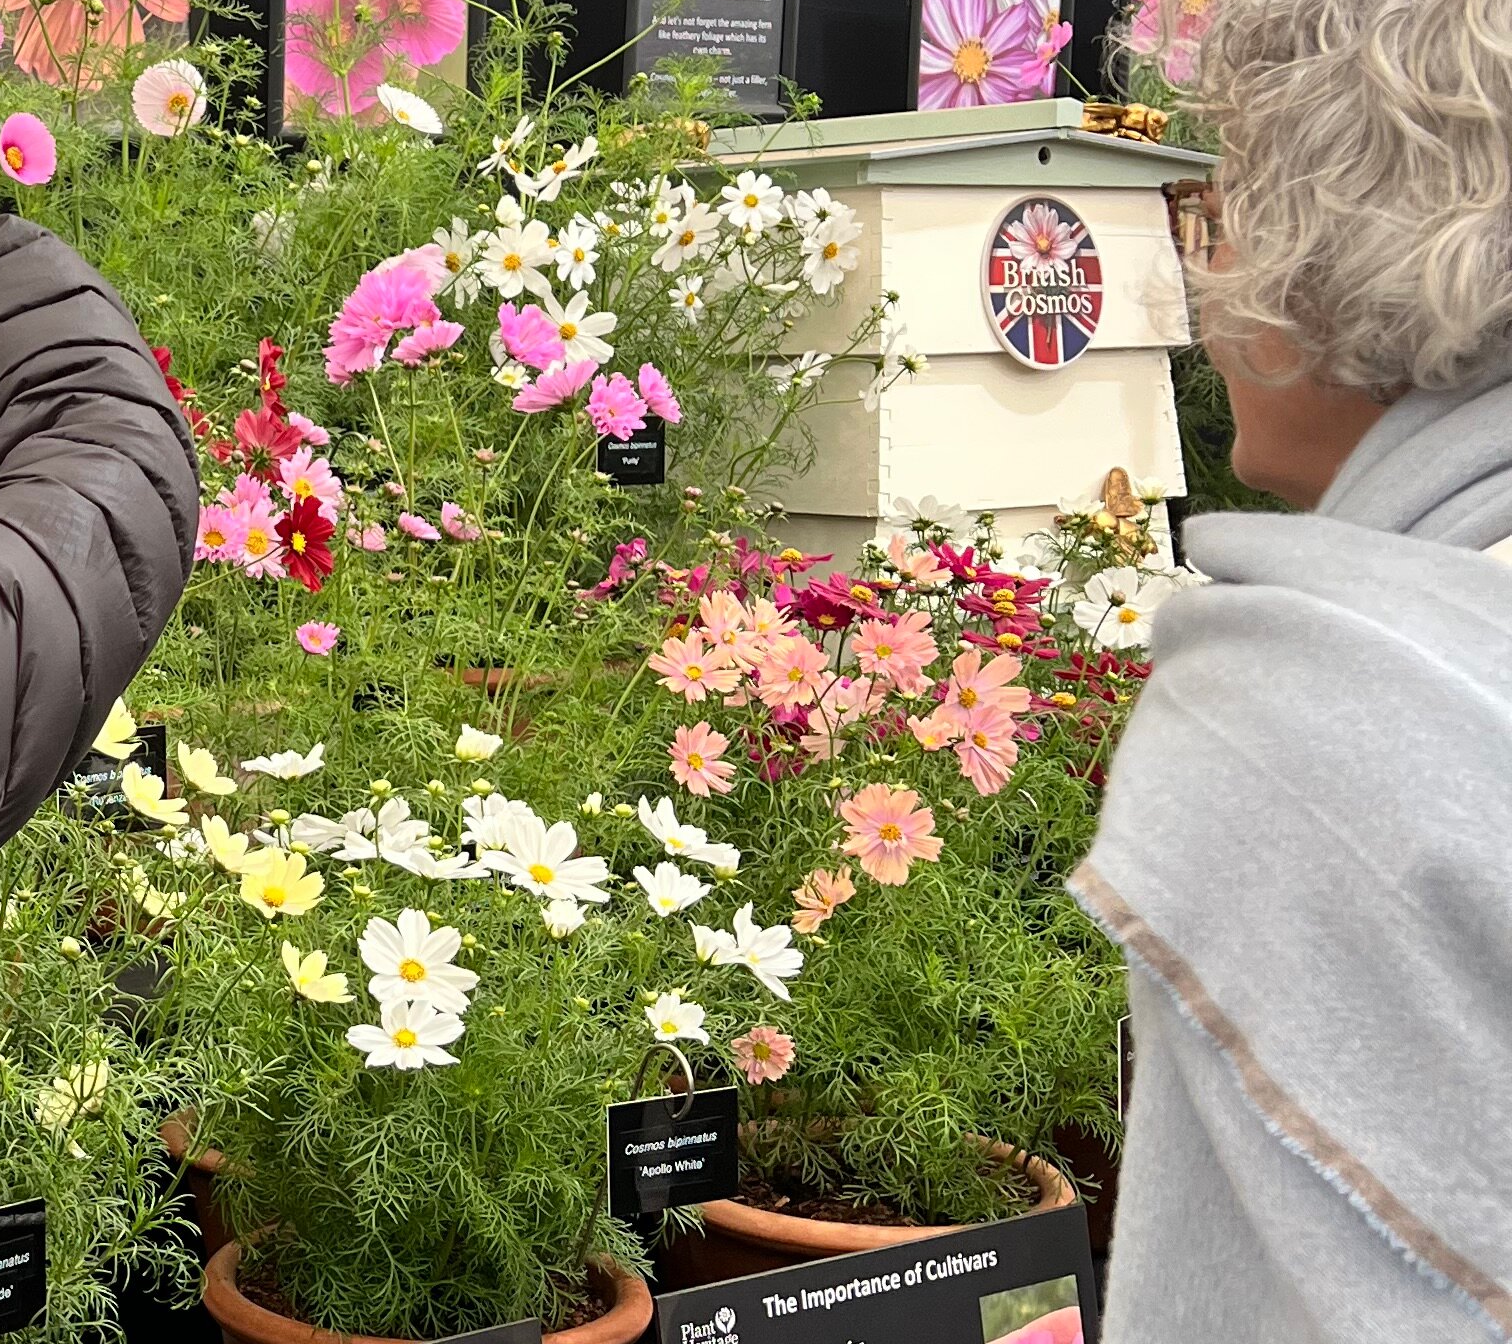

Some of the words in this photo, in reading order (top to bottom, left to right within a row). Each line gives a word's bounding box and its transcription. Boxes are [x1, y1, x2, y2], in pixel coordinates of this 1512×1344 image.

[1002, 259, 1088, 290] British
[1005, 287, 1093, 316] Cosmos
[624, 1140, 665, 1156] Cosmos
[667, 1131, 718, 1148] bipinnatus
[639, 1161, 673, 1178] 'Apollo
[675, 1157, 706, 1173] White'
[762, 1293, 798, 1318] The
[800, 1272, 901, 1310] Importance
[904, 1261, 923, 1286] of
[925, 1250, 998, 1281] Cultivars
[680, 1319, 717, 1344] Plant
